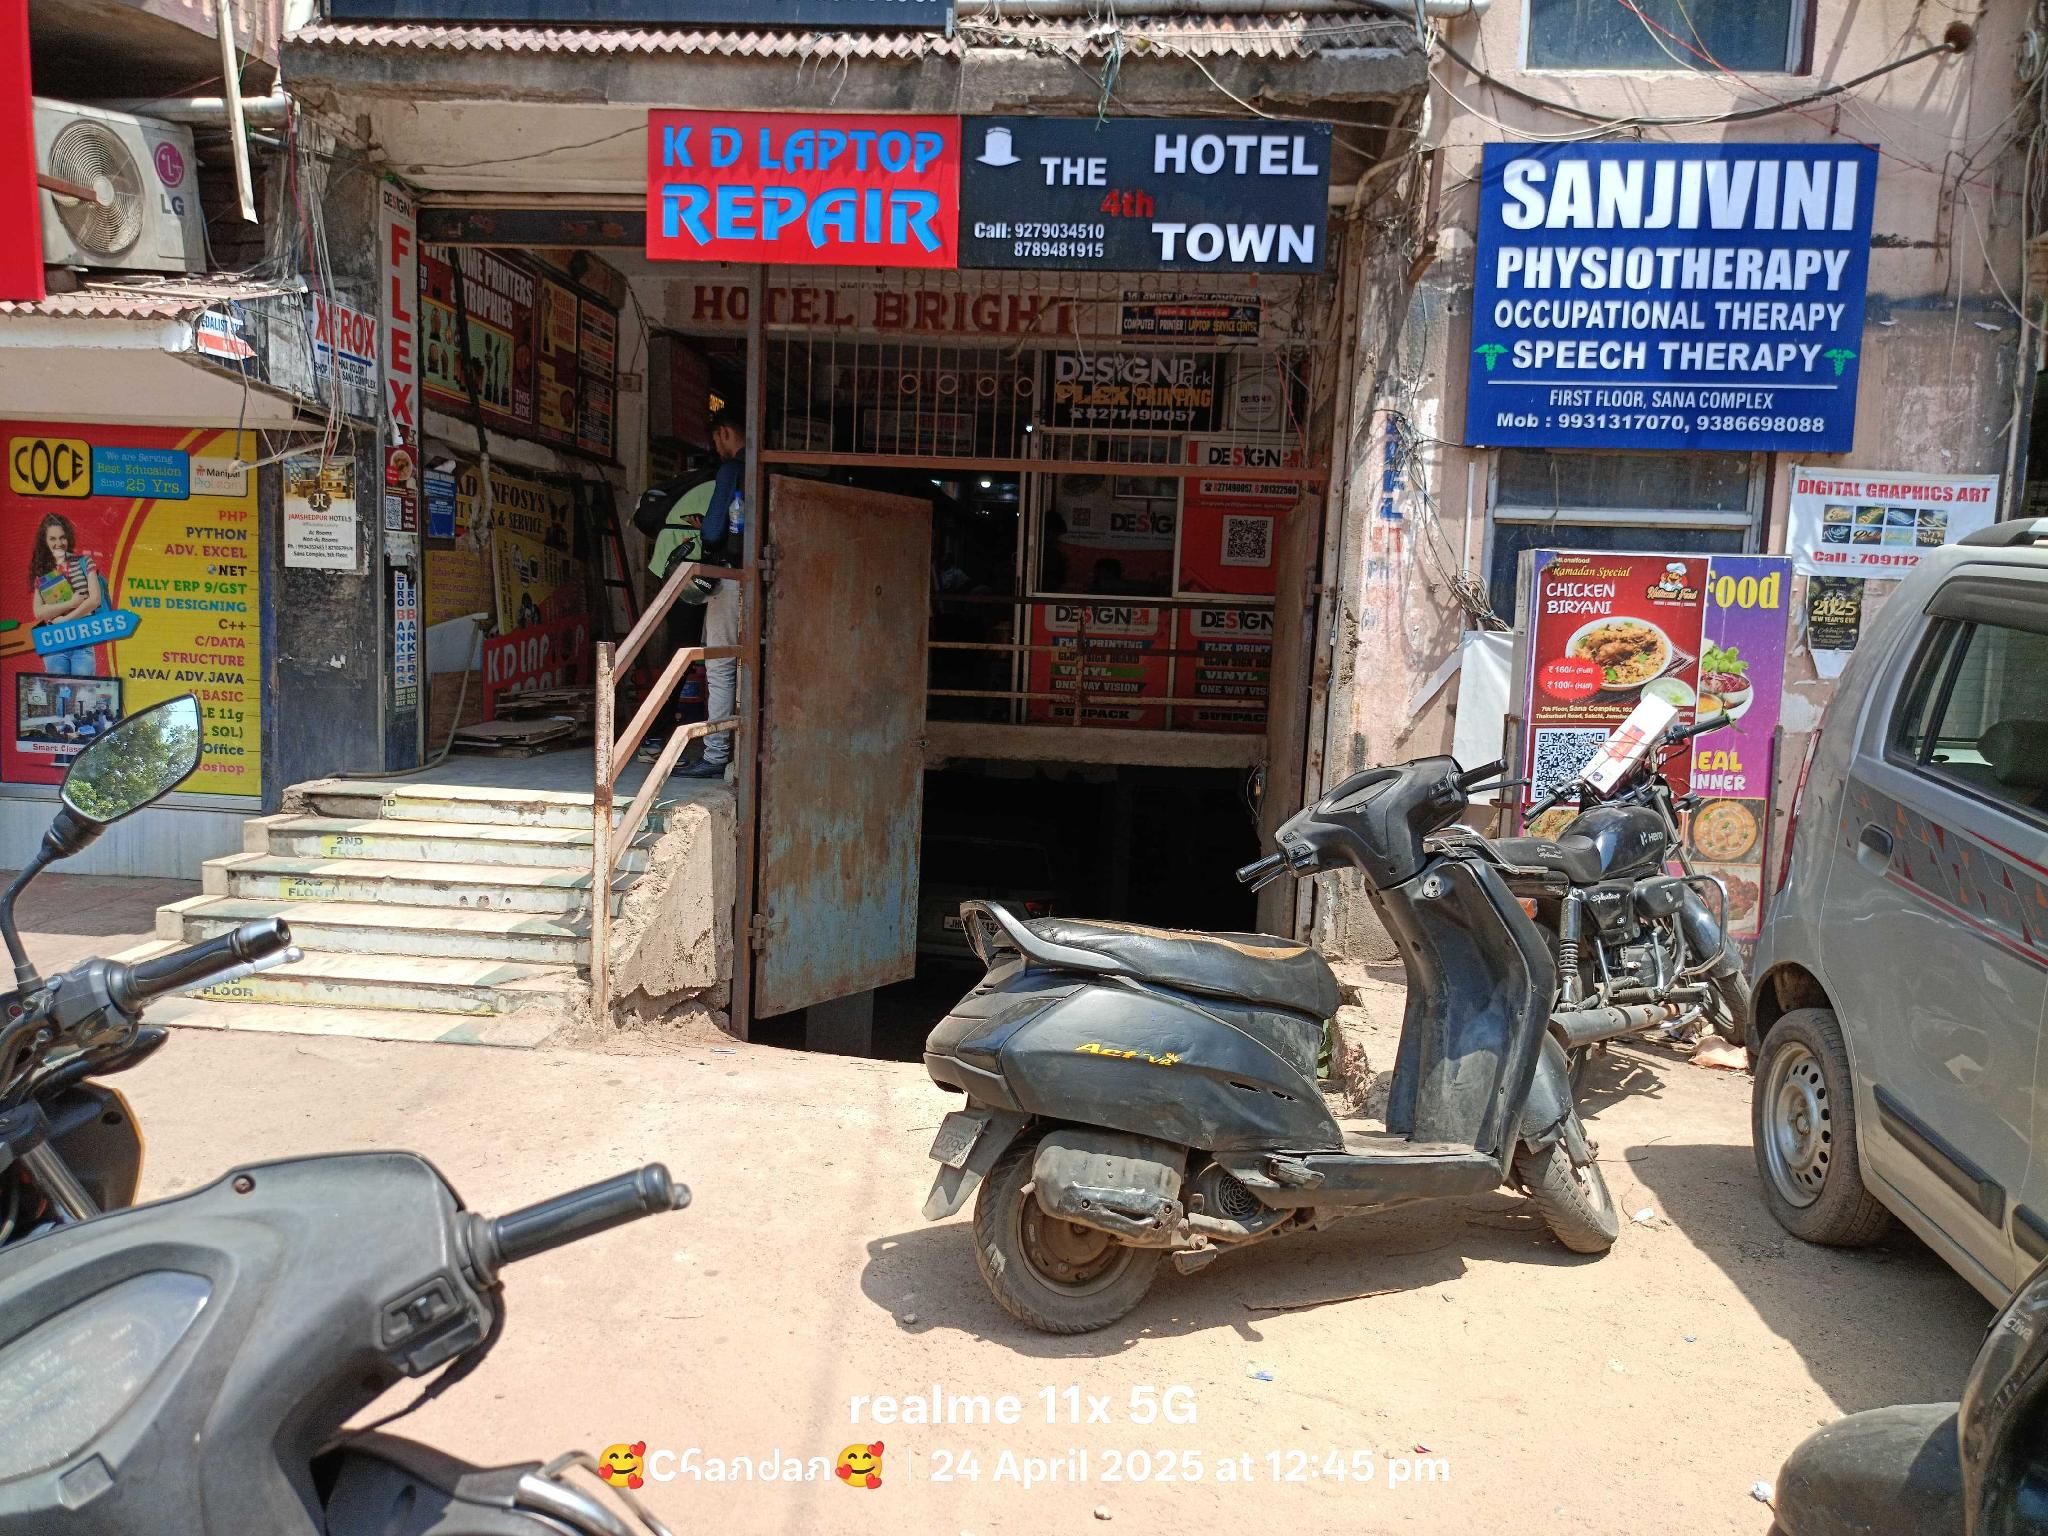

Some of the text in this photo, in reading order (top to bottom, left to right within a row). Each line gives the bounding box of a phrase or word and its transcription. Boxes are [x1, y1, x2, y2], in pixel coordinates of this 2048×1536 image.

[663, 125, 944, 174] K D LAPTOP
[1153, 133, 1319, 176] HOTEL
[1040, 157, 1107, 186] THE
[1502, 159, 1859, 231] SANJIVINI
[160, 193, 185, 216] LG
[1100, 189, 1154, 218] 4th
[660, 183, 942, 252] REPAIR
[1015, 223, 1105, 240] 9279034510
[1013, 241, 1105, 258] 8789481915
[1151, 222, 1315, 264] TOWN
[1496, 246, 1851, 291] PHYSIOTHERAPY
[484, 256, 533, 308] PRINTERS
[462, 276, 512, 330] TROPHIES
[691, 285, 1079, 335] HOTEL BRIGHT
[389, 223, 413, 425] FLEX
[1493, 300, 1845, 332] OCCUPATIONAL THERAPY
[1123, 319, 1155, 330] COMPUTER
[1159, 320, 1183, 331] PRINTER
[1511, 339, 1823, 373] SPEECH THERAPY
[514, 389, 530, 405] THIS
[1135, 386, 1211, 407] PRINTING
[1550, 389, 1774, 410] FIRST FLOOR, SANA COMPLEX
[515, 404, 530, 418] SIDE
[1497, 412, 1825, 434] Mob 9931317070, 9386698088
[15, 440, 84, 491] COCE
[124, 454, 137, 462] are
[138, 453, 173, 464] Serving
[96, 462, 182, 476] Best Education
[126, 478, 146, 492] 25
[1797, 479, 1992, 503] DIGITAL GRAPHICS ART
[219, 511, 247, 522] PHP
[288, 513, 328, 521] JAMSHEDPUR
[186, 526, 247, 540] PYTHON
[164, 544, 247, 559] ADV. EXCEL
[1812, 550, 1923, 567] Call 709112
[1597, 566, 1632, 579] Special
[128, 578, 248, 595] TALLY ERP 9/GST
[1546, 582, 1615, 598] CHICKEN
[129, 596, 248, 613] WEB DESIGNING
[1547, 599, 1612, 614] BIRYANI
[1812, 599, 1857, 616] 2025
[41, 615, 128, 647] COURSES
[219, 619, 247, 631] C++
[194, 636, 245, 649] C/DATA
[1089, 638, 1143, 649] PRINTING
[1204, 642, 1232, 652] FLEX
[162, 652, 245, 667] STRUCTURE
[128, 668, 171, 680] JAVA/
[1205, 671, 1258, 681] VINYL
[1055, 680, 1139, 692] ONE VISION
[1200, 684, 1222, 693] ONE
[1224, 685, 1249, 694] WAY
[219, 708, 244, 722] 11g
[1588, 705, 1622, 713] Complex,
[212, 726, 244, 739] SQL)
[33, 743, 58, 752] Smart
[202, 743, 245, 756] Office
[1692, 750, 1743, 773] EAL
[336, 836, 364, 845] 2ND
[1648, 832, 1663, 843] Hero
[203, 986, 254, 997] FLOOR
